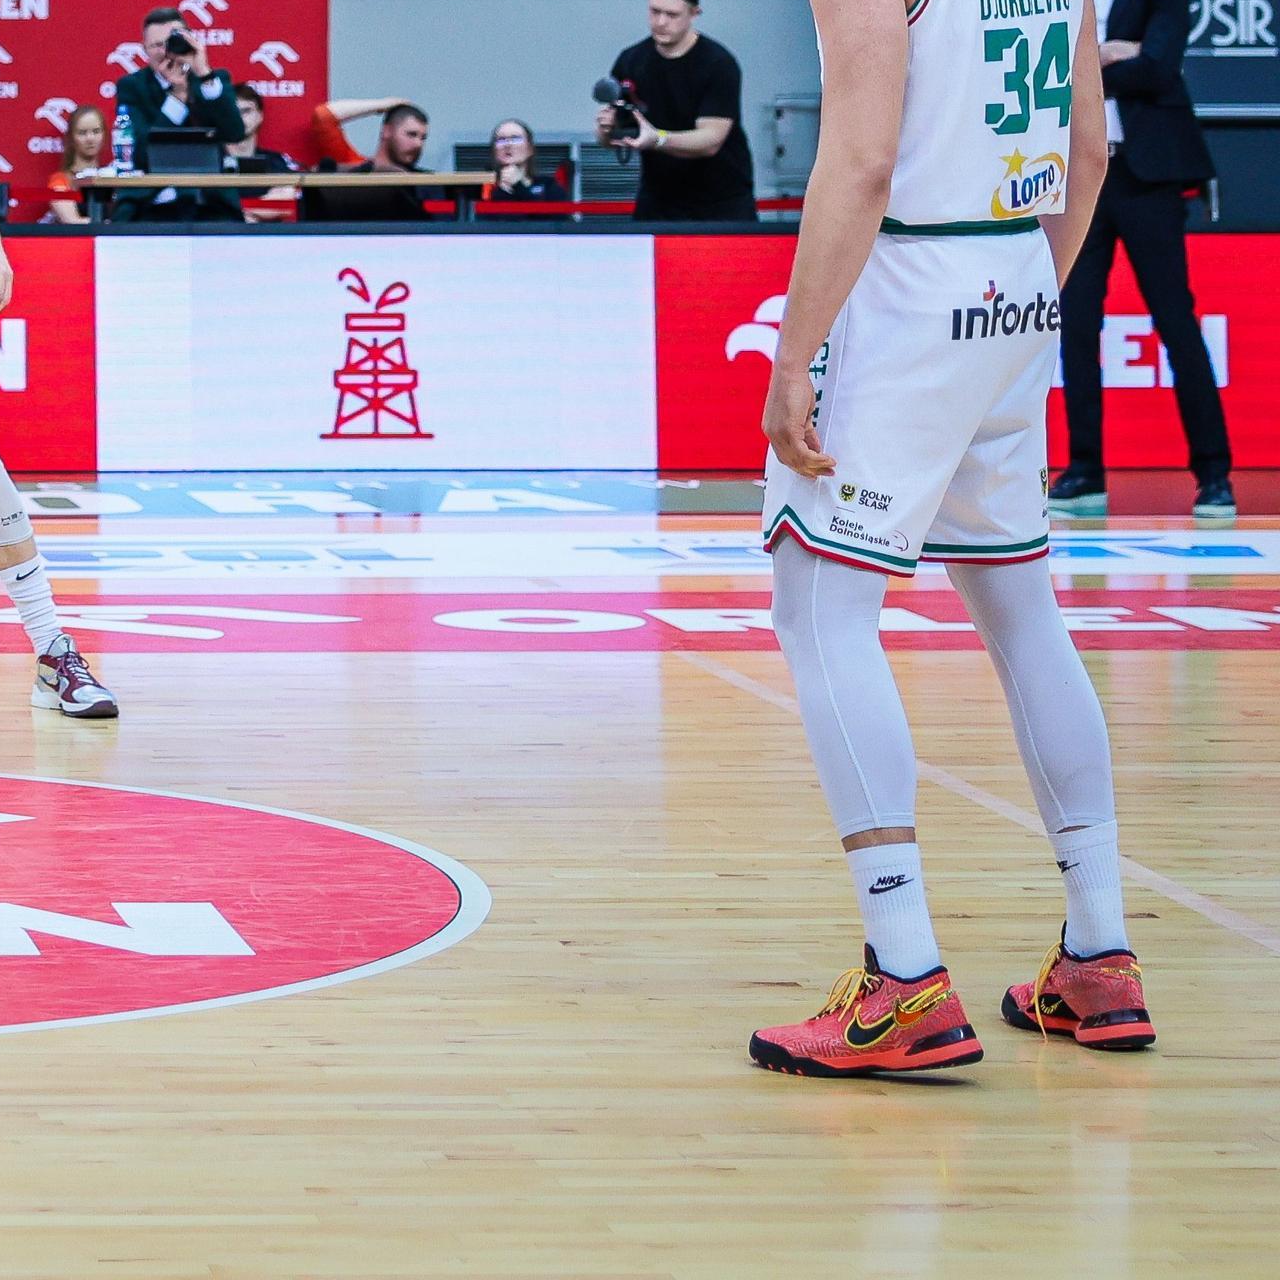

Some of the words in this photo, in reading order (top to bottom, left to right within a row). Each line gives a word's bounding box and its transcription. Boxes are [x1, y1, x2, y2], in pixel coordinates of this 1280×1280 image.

[983, 21, 1072, 136] 34
[1010, 164, 1056, 209] LOTTO
[860, 489, 894, 505] DOLNY
[831, 515, 865, 532] Koleje
[875, 873, 907, 887] NIKE
